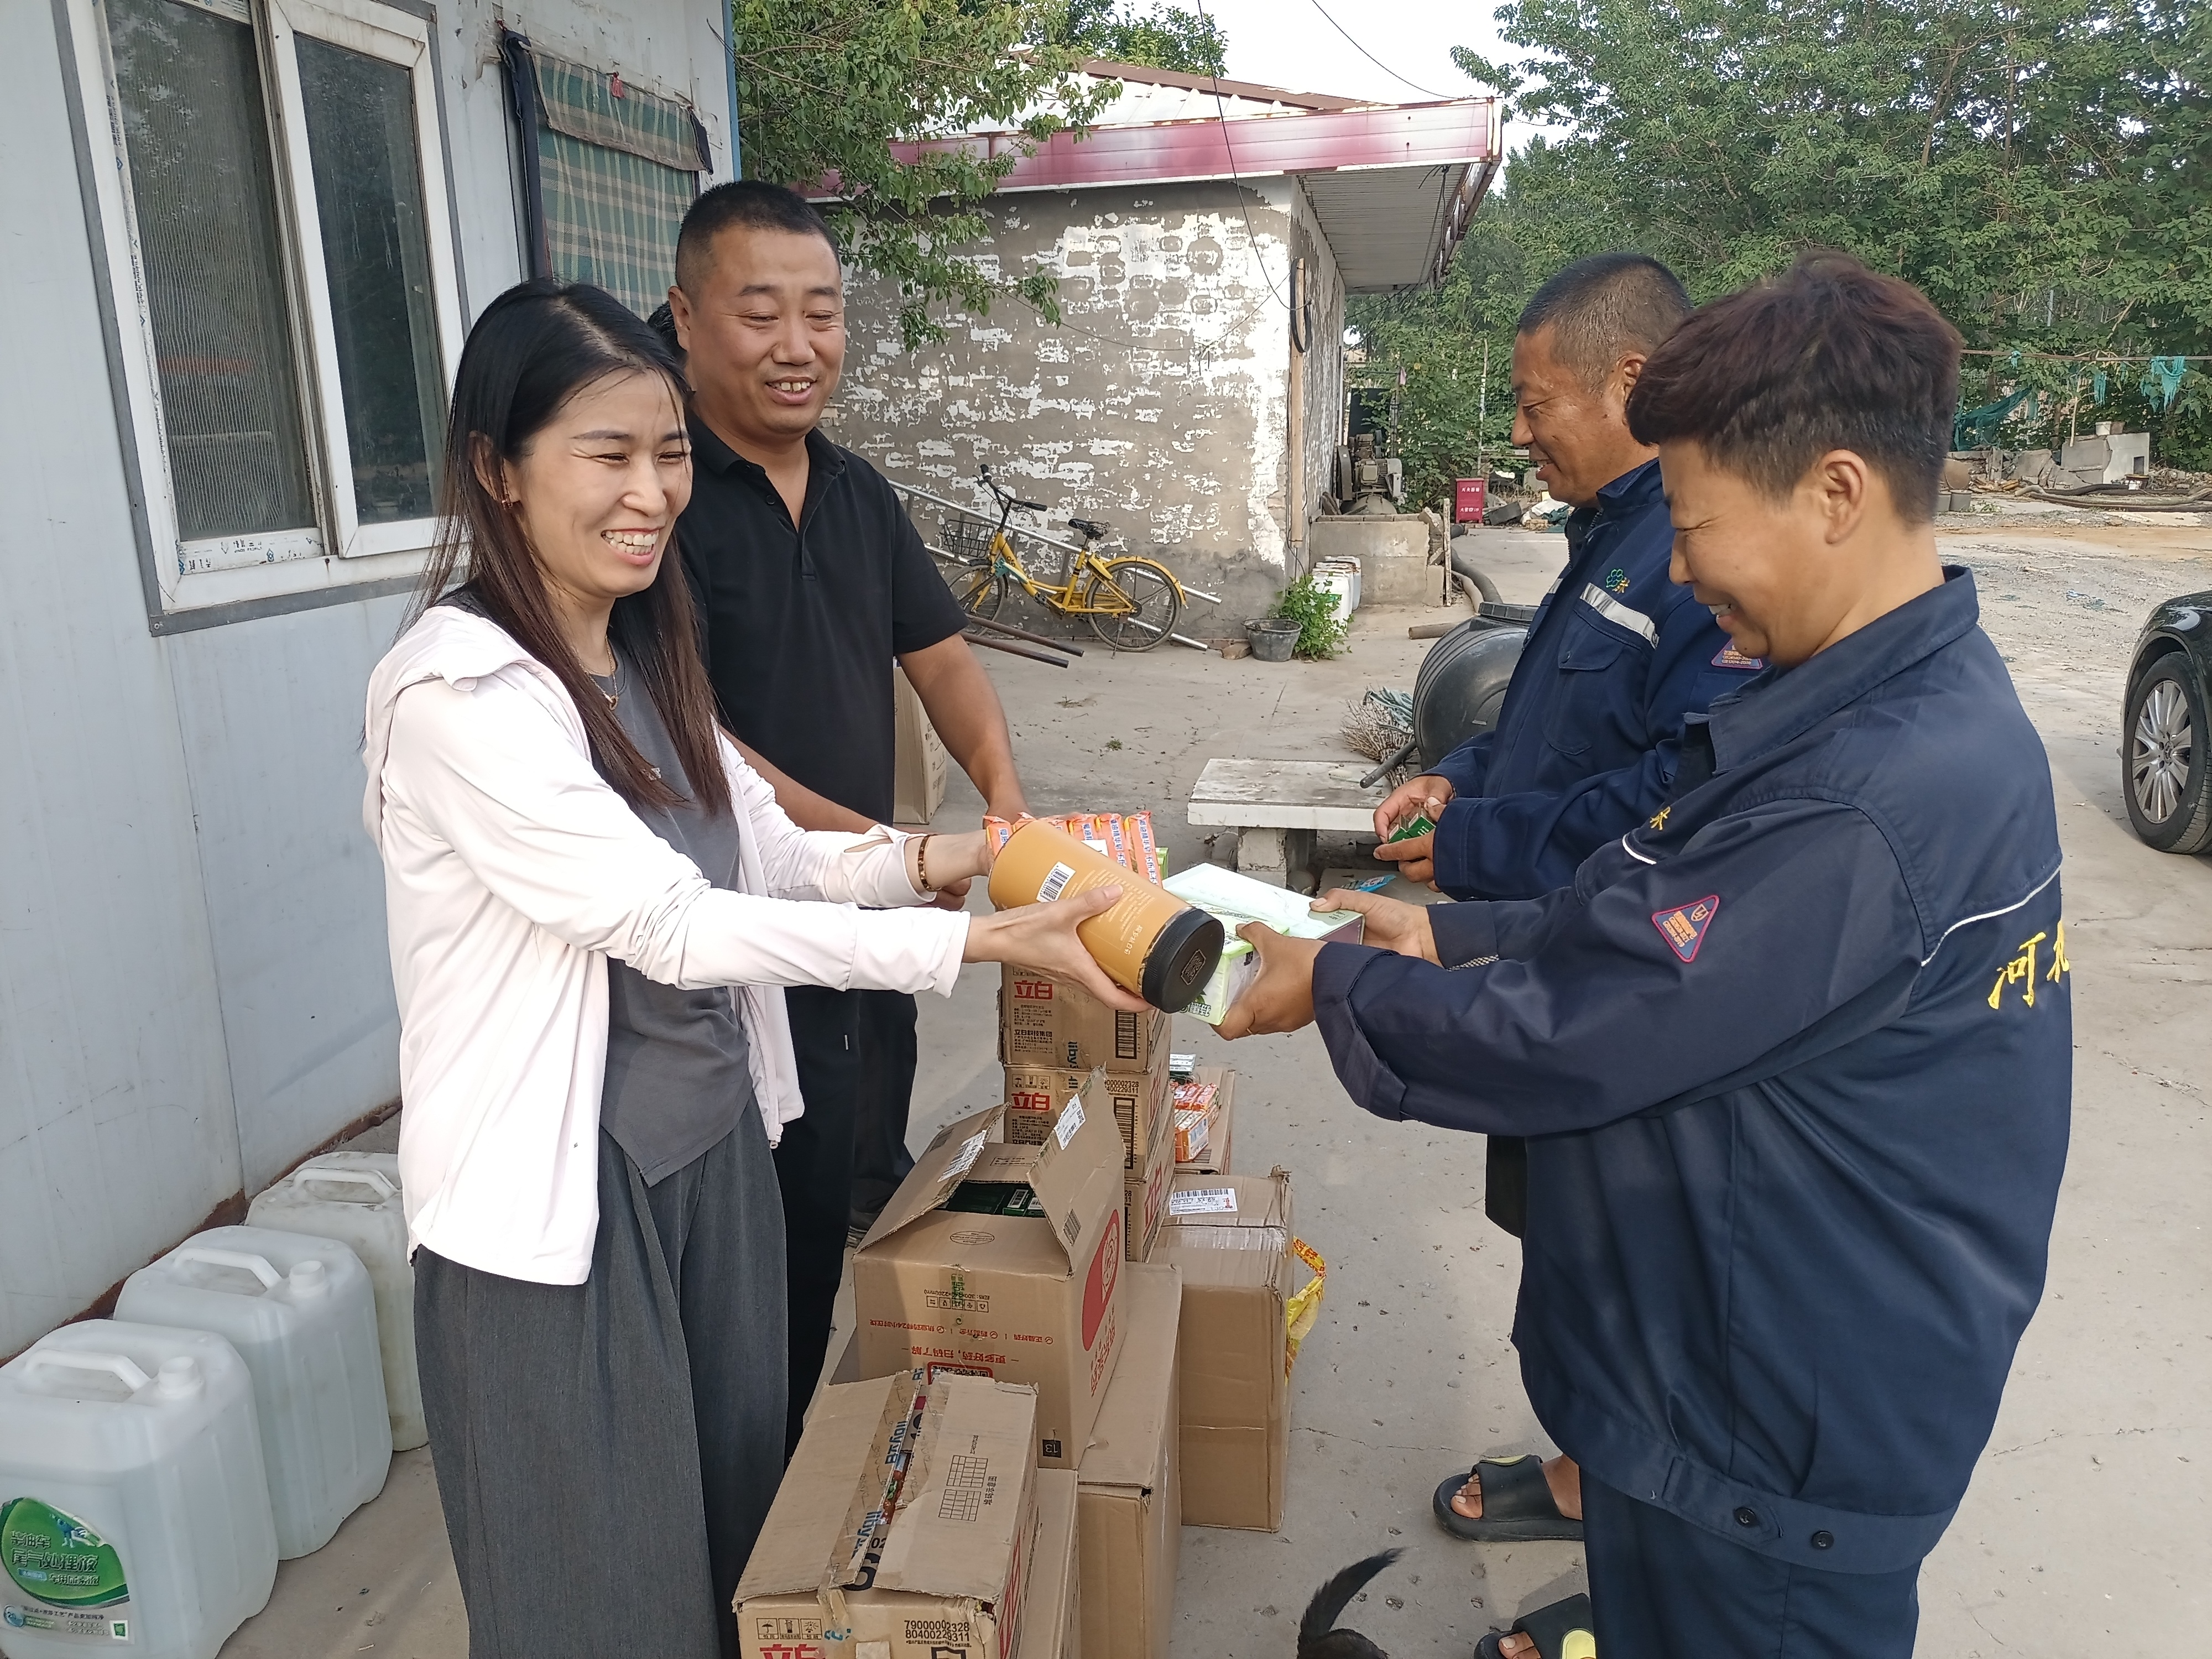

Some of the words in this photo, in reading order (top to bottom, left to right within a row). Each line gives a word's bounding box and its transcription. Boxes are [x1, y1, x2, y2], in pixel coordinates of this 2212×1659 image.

[1014, 980, 1053, 1000] 立白
[1011, 1091, 1050, 1111] 立白
[1045, 1443, 1058, 1454] 13
[11, 1547, 100, 1573] 尾气处理液
[904, 1619, 970, 1633] 79000002328
[905, 1629, 970, 1642] 80400229311
